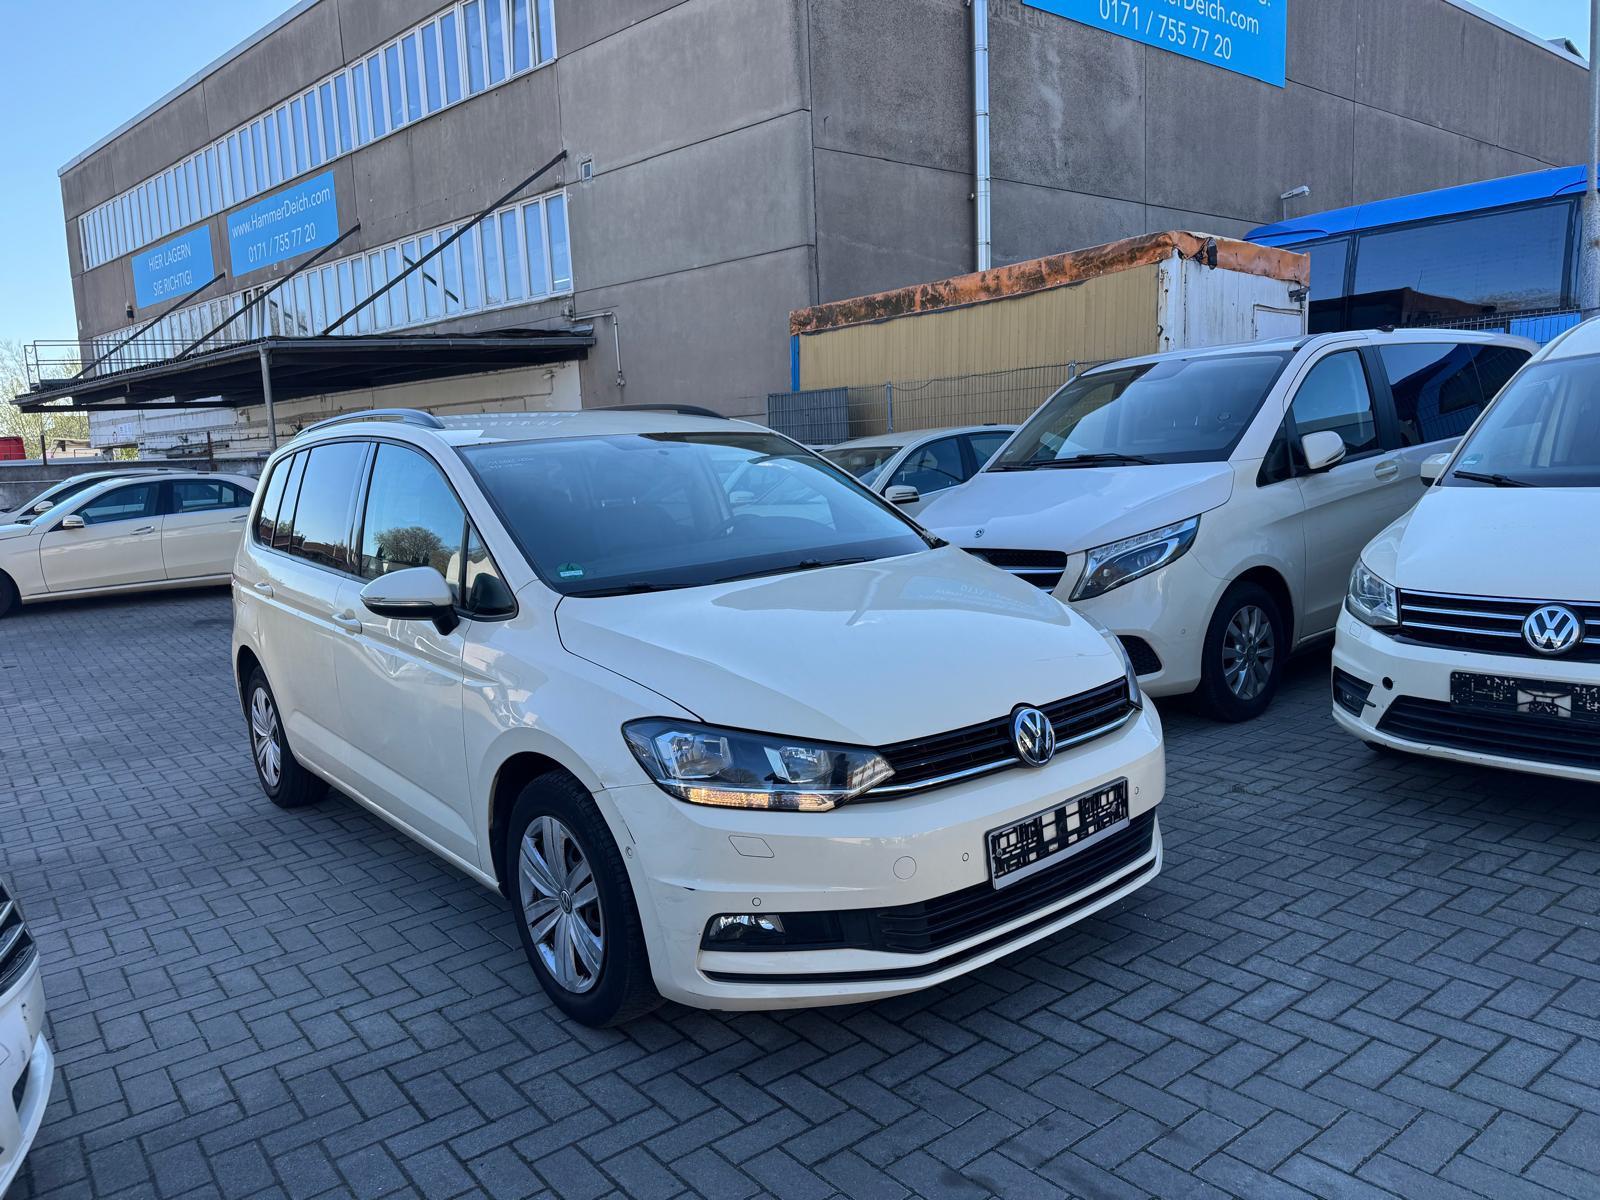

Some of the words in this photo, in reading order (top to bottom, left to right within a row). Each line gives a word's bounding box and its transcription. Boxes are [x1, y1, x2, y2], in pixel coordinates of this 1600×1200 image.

[1100, 0, 1139, 31] 0171
[1145, 10, 1154, 35] /
[1158, 14, 1187, 46] 755
[1191, 26, 1209, 52] 77
[1214, 34, 1232, 60] 20
[231, 187, 331, 239] www.HammerDeich.com
[148, 254, 164, 273] HIER
[163, 241, 192, 266] LAGERN
[248, 242, 267, 263] 0171
[275, 231, 290, 253] 755
[291, 227, 302, 247] 77
[304, 222, 316, 243] 20
[153, 280, 164, 296] SIE
[163, 269, 193, 294] RICHTIG!
[1526, 607, 1577, 652] VW
